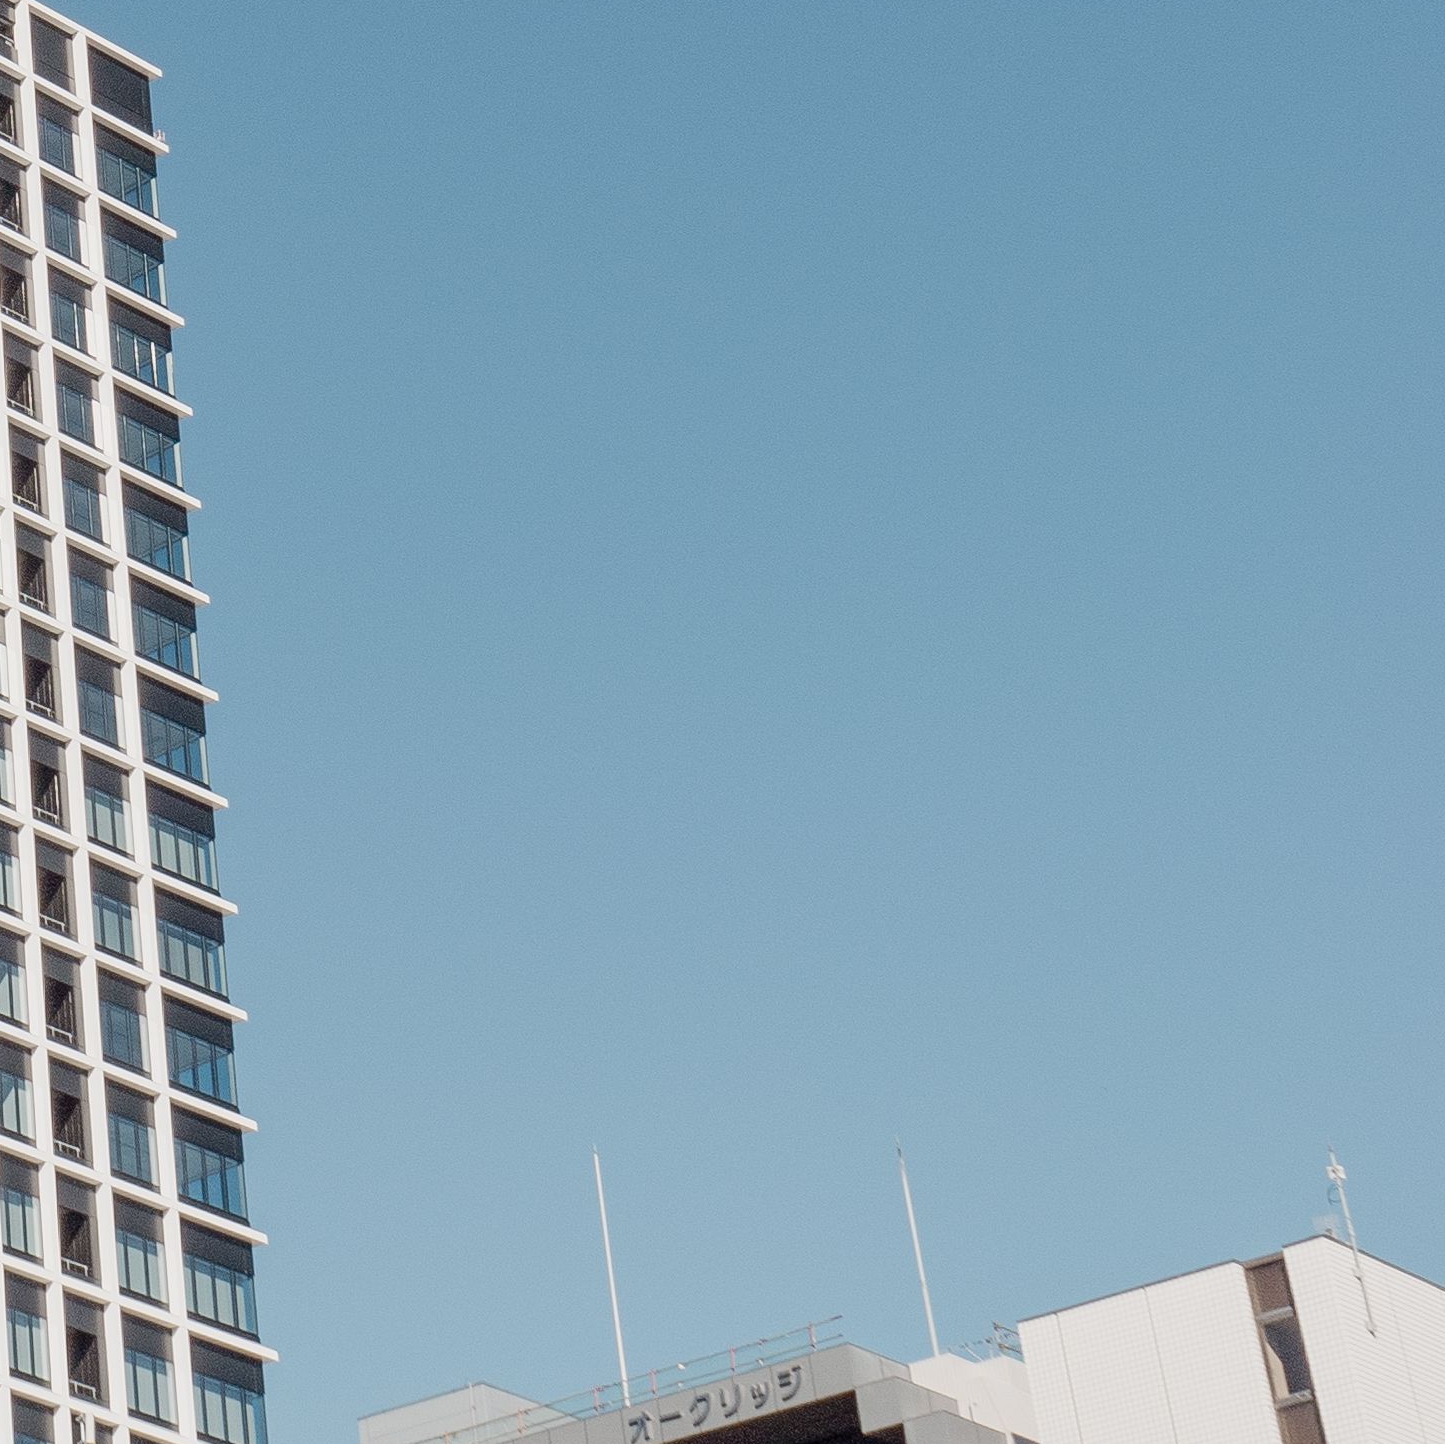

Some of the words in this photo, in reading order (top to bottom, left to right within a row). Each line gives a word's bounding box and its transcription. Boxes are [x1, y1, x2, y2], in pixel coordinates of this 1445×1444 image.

[629, 1365, 803, 1444] オークリッジ
